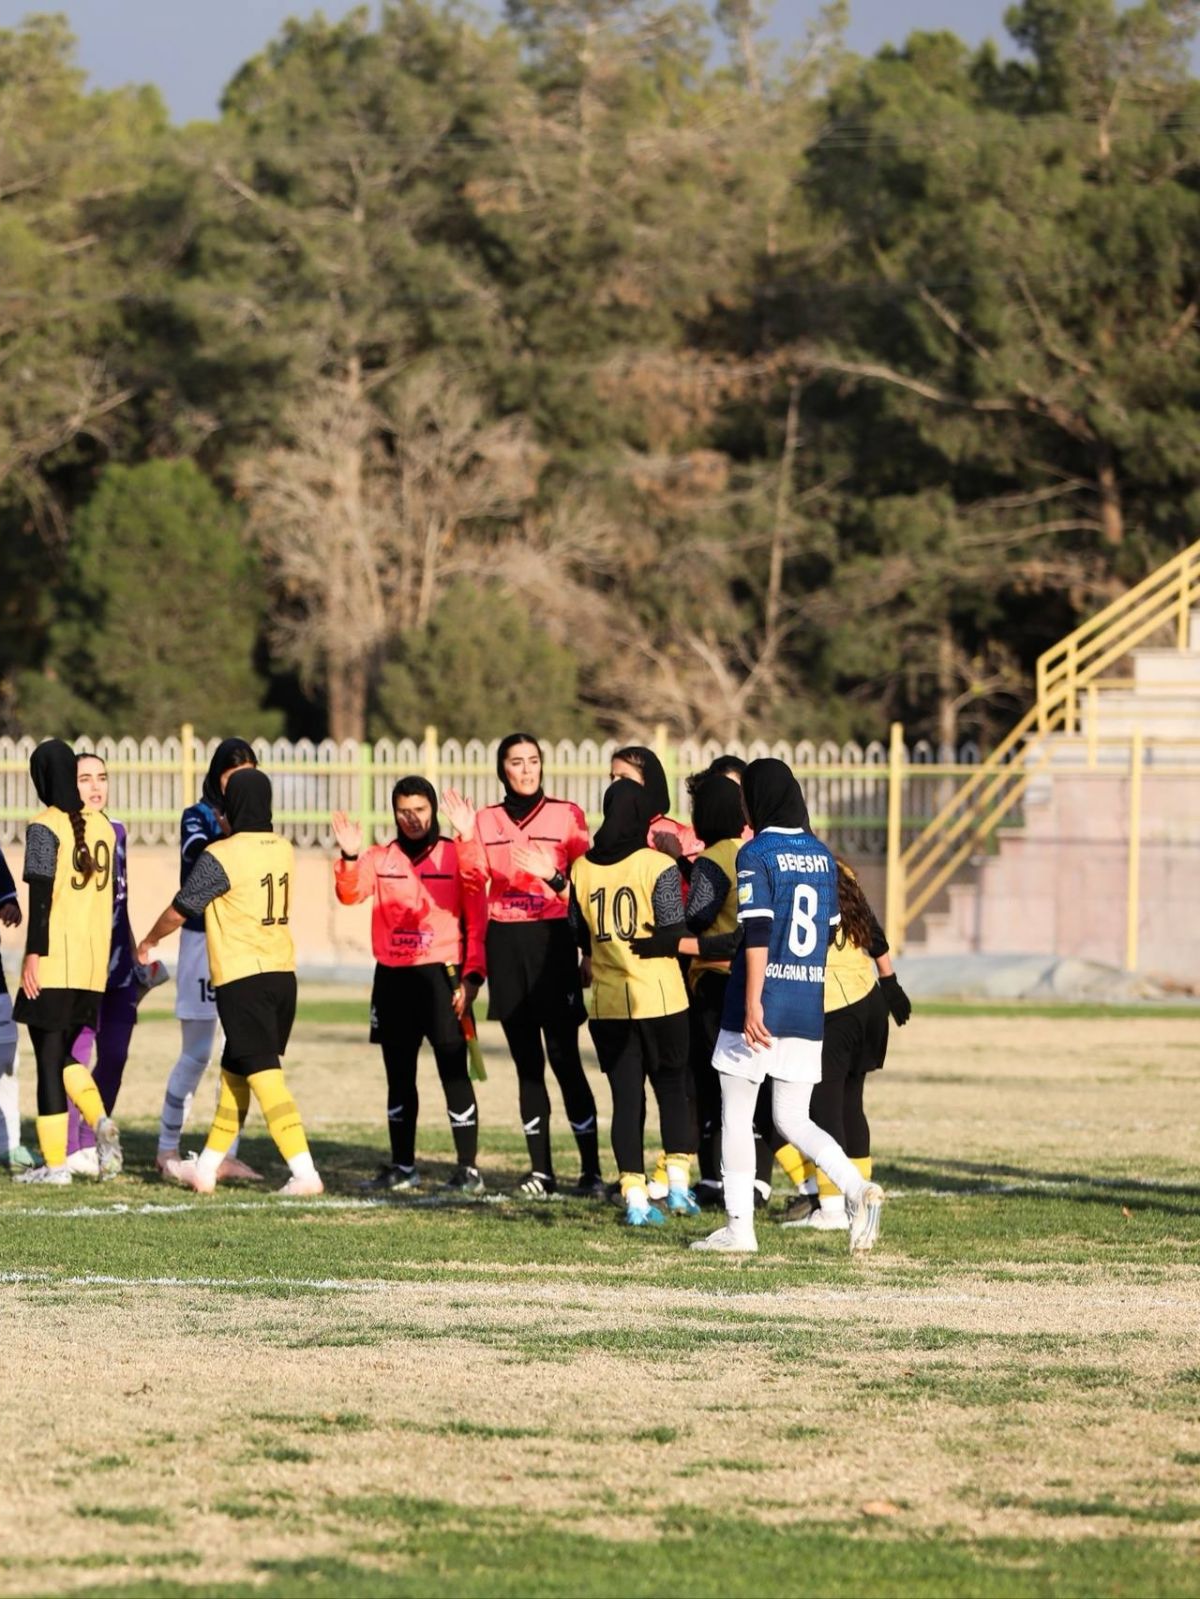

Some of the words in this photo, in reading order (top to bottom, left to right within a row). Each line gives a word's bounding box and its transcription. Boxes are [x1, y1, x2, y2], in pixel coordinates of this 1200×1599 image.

[71, 840, 110, 892] 99
[260, 872, 289, 926] 11
[590, 886, 638, 943] 10
[788, 883, 818, 958] 8
